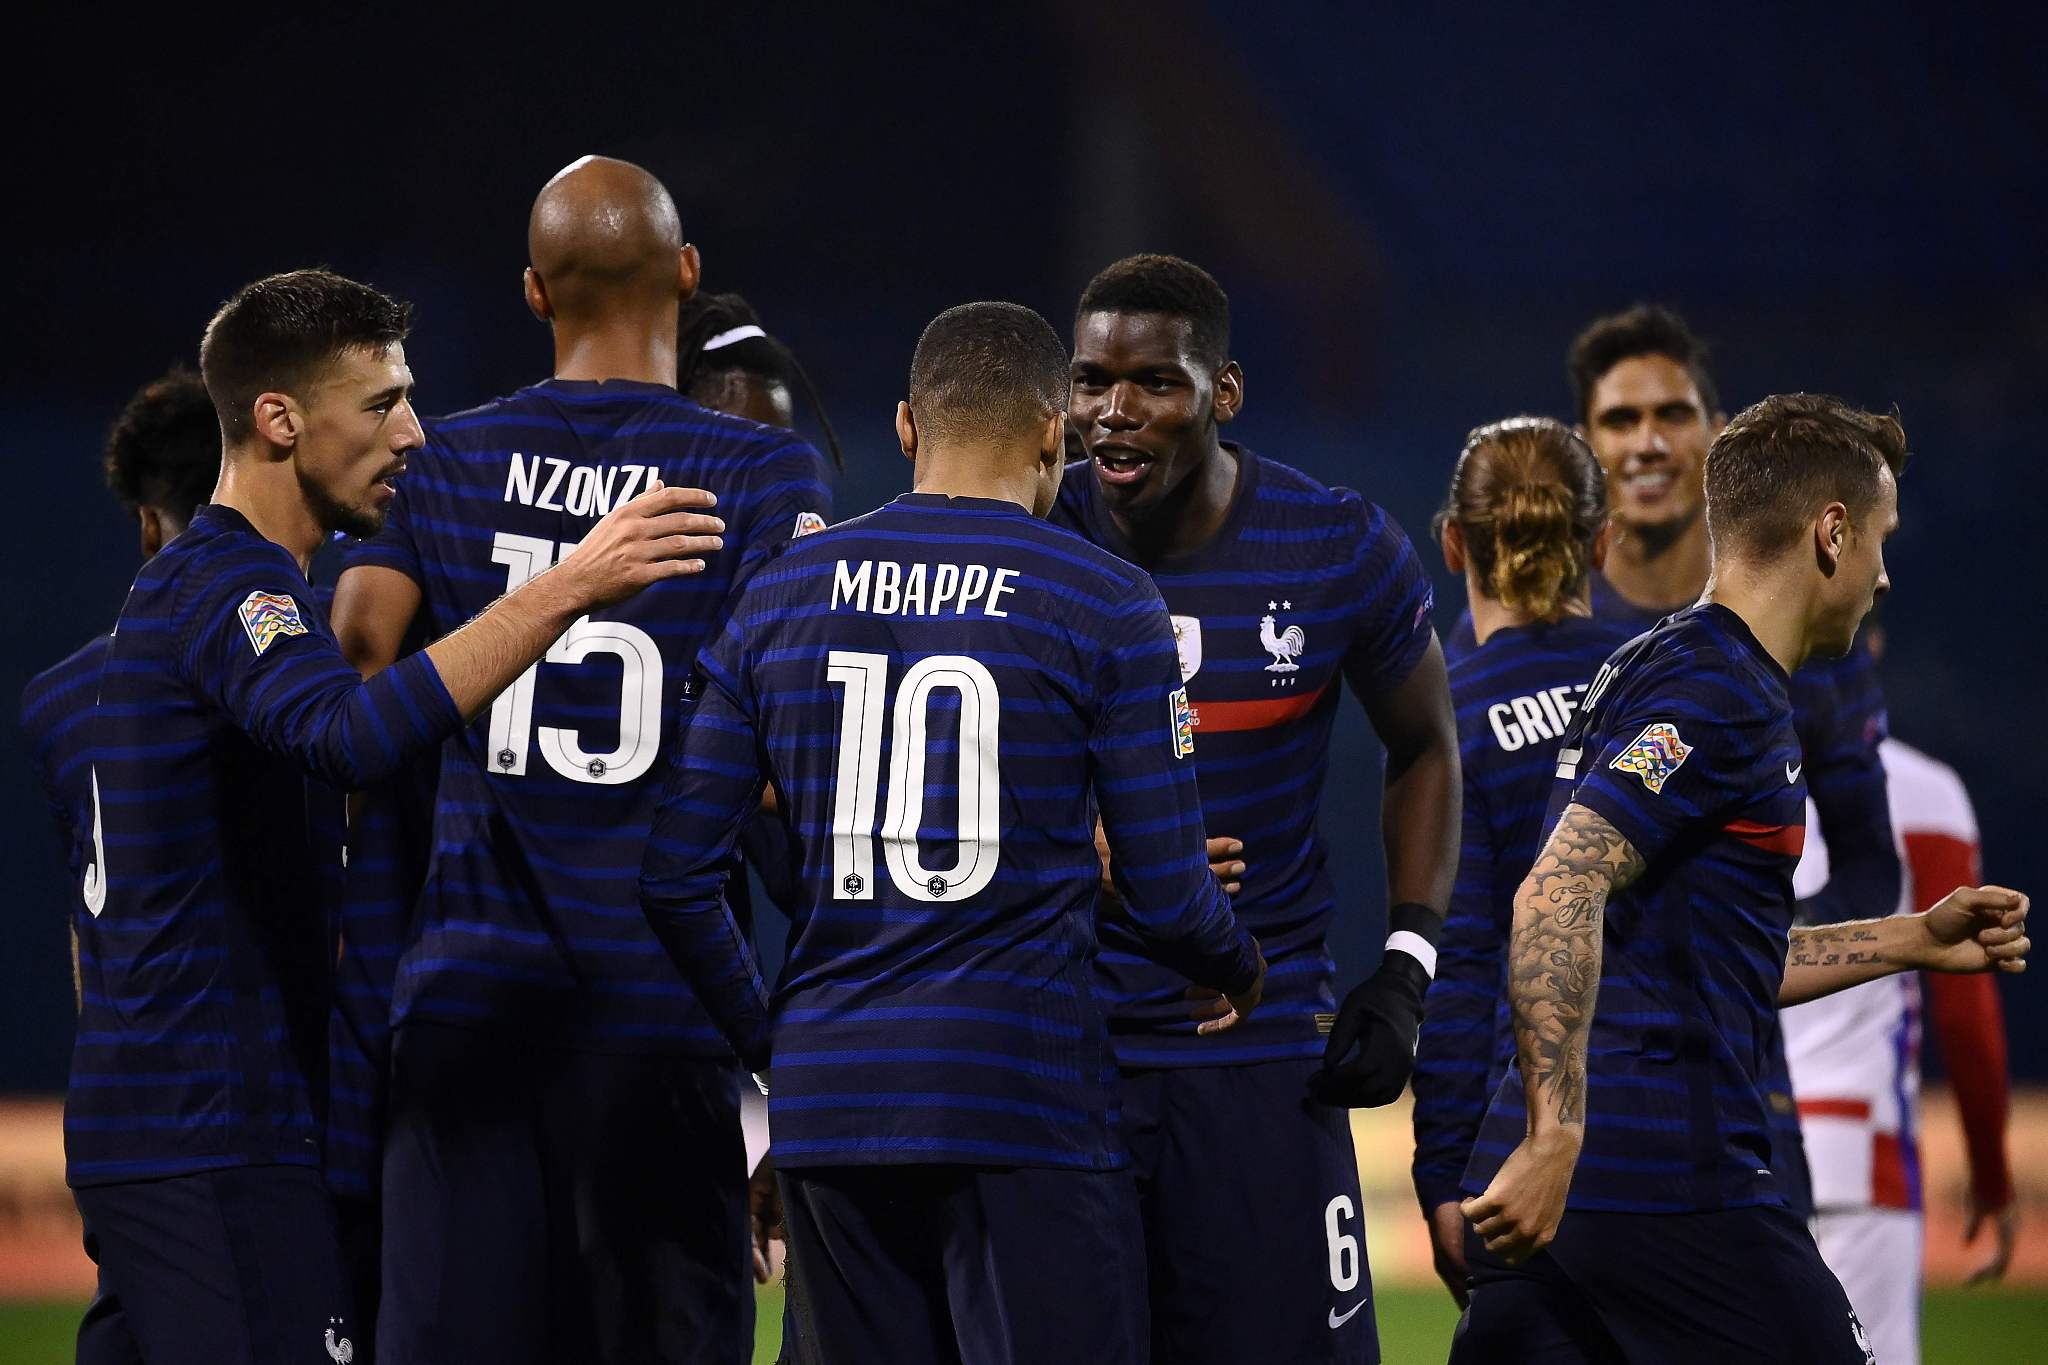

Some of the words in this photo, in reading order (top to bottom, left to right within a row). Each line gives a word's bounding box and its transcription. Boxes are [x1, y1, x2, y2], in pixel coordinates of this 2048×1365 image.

[830, 559, 1021, 617] MBAPPE
[487, 532, 663, 784] 15
[1487, 683, 1589, 752] GRIE
[827, 651, 1000, 901] 10
[1325, 1195, 1359, 1292] 6
